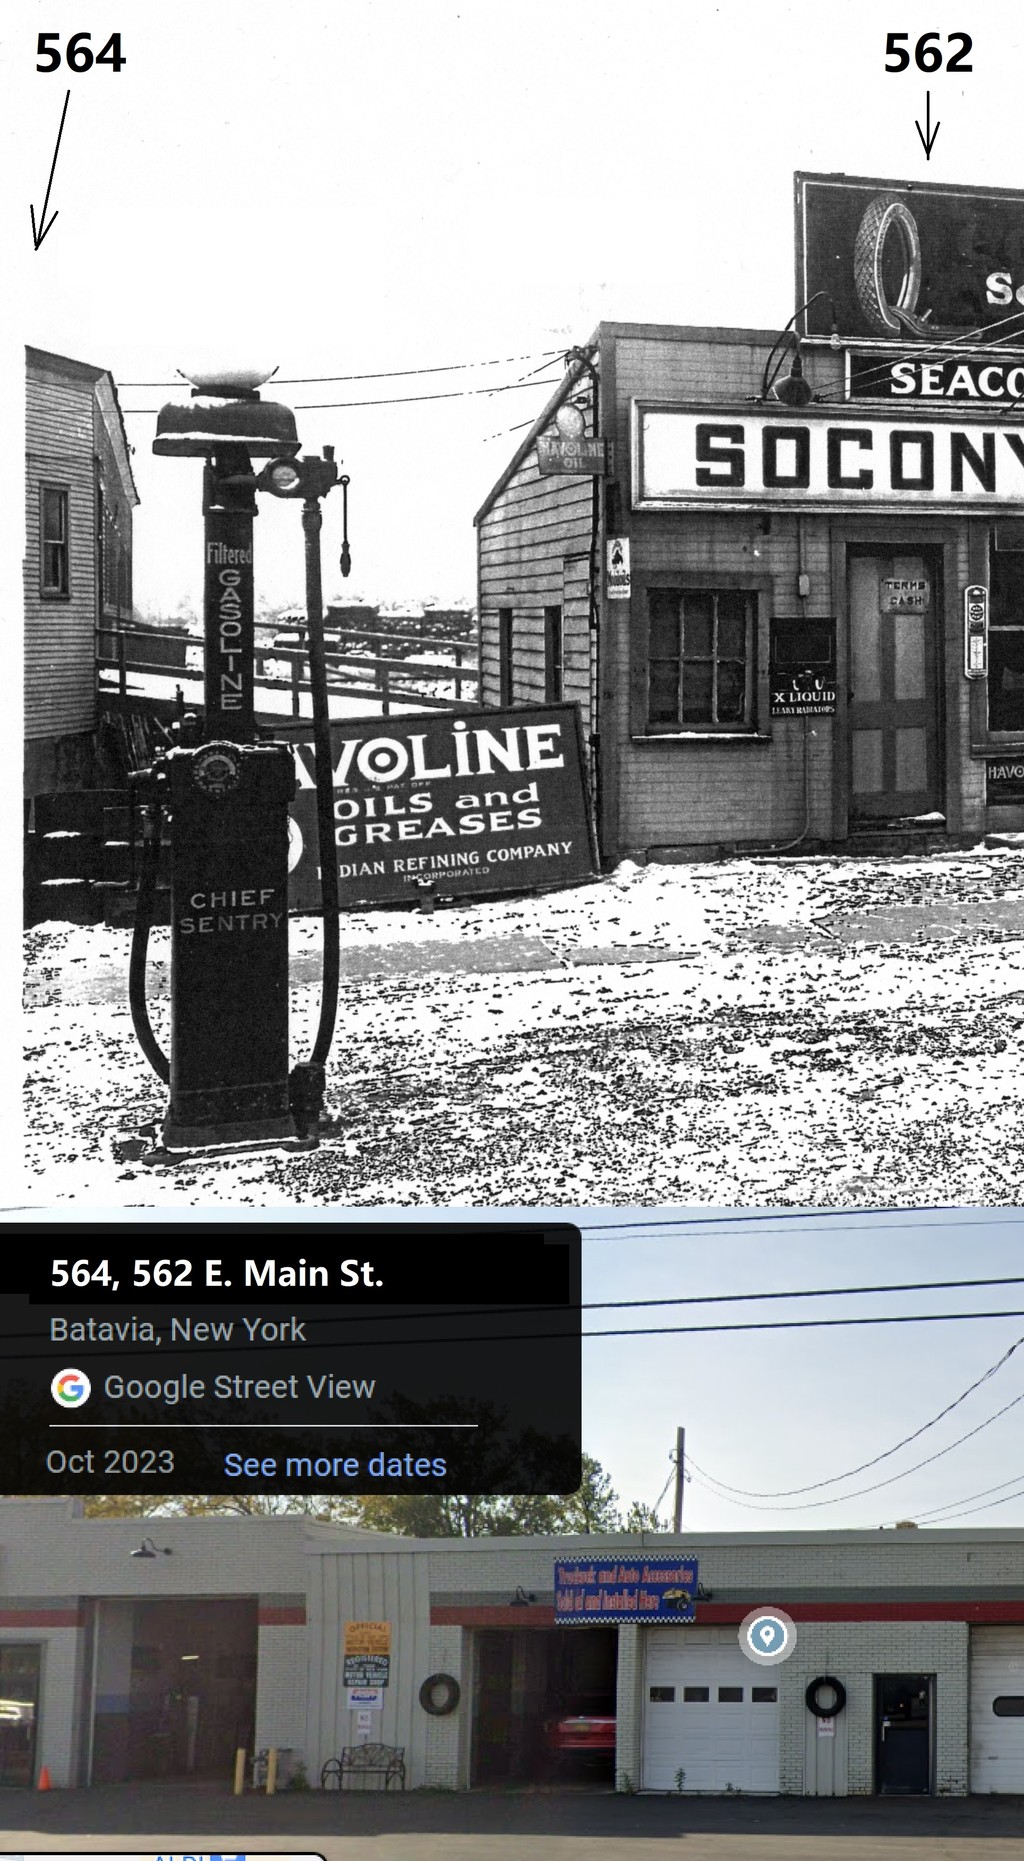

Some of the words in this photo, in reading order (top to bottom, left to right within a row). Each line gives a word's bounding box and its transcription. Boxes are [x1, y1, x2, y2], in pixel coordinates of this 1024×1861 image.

[563, 457, 585, 469] OIL
[206, 542, 253, 565] Filtered
[884, 581, 926, 590] TERMS
[890, 596, 923, 606] CASH
[219, 568, 243, 711] GASOLINE
[789, 690, 836, 703] LIQUID
[771, 706, 795, 715] LEAKY
[287, 721, 564, 789] AVOLINE
[333, 791, 433, 820] OILS
[454, 782, 540, 810] and
[334, 807, 543, 847] GREASES
[316, 860, 386, 880] IDIAN
[393, 850, 481, 873] REFINING
[486, 841, 574, 864] COMPANY
[403, 866, 490, 883] INCORPORATED
[190, 888, 276, 909] CHIEF
[179, 912, 284, 934] SENTRY
